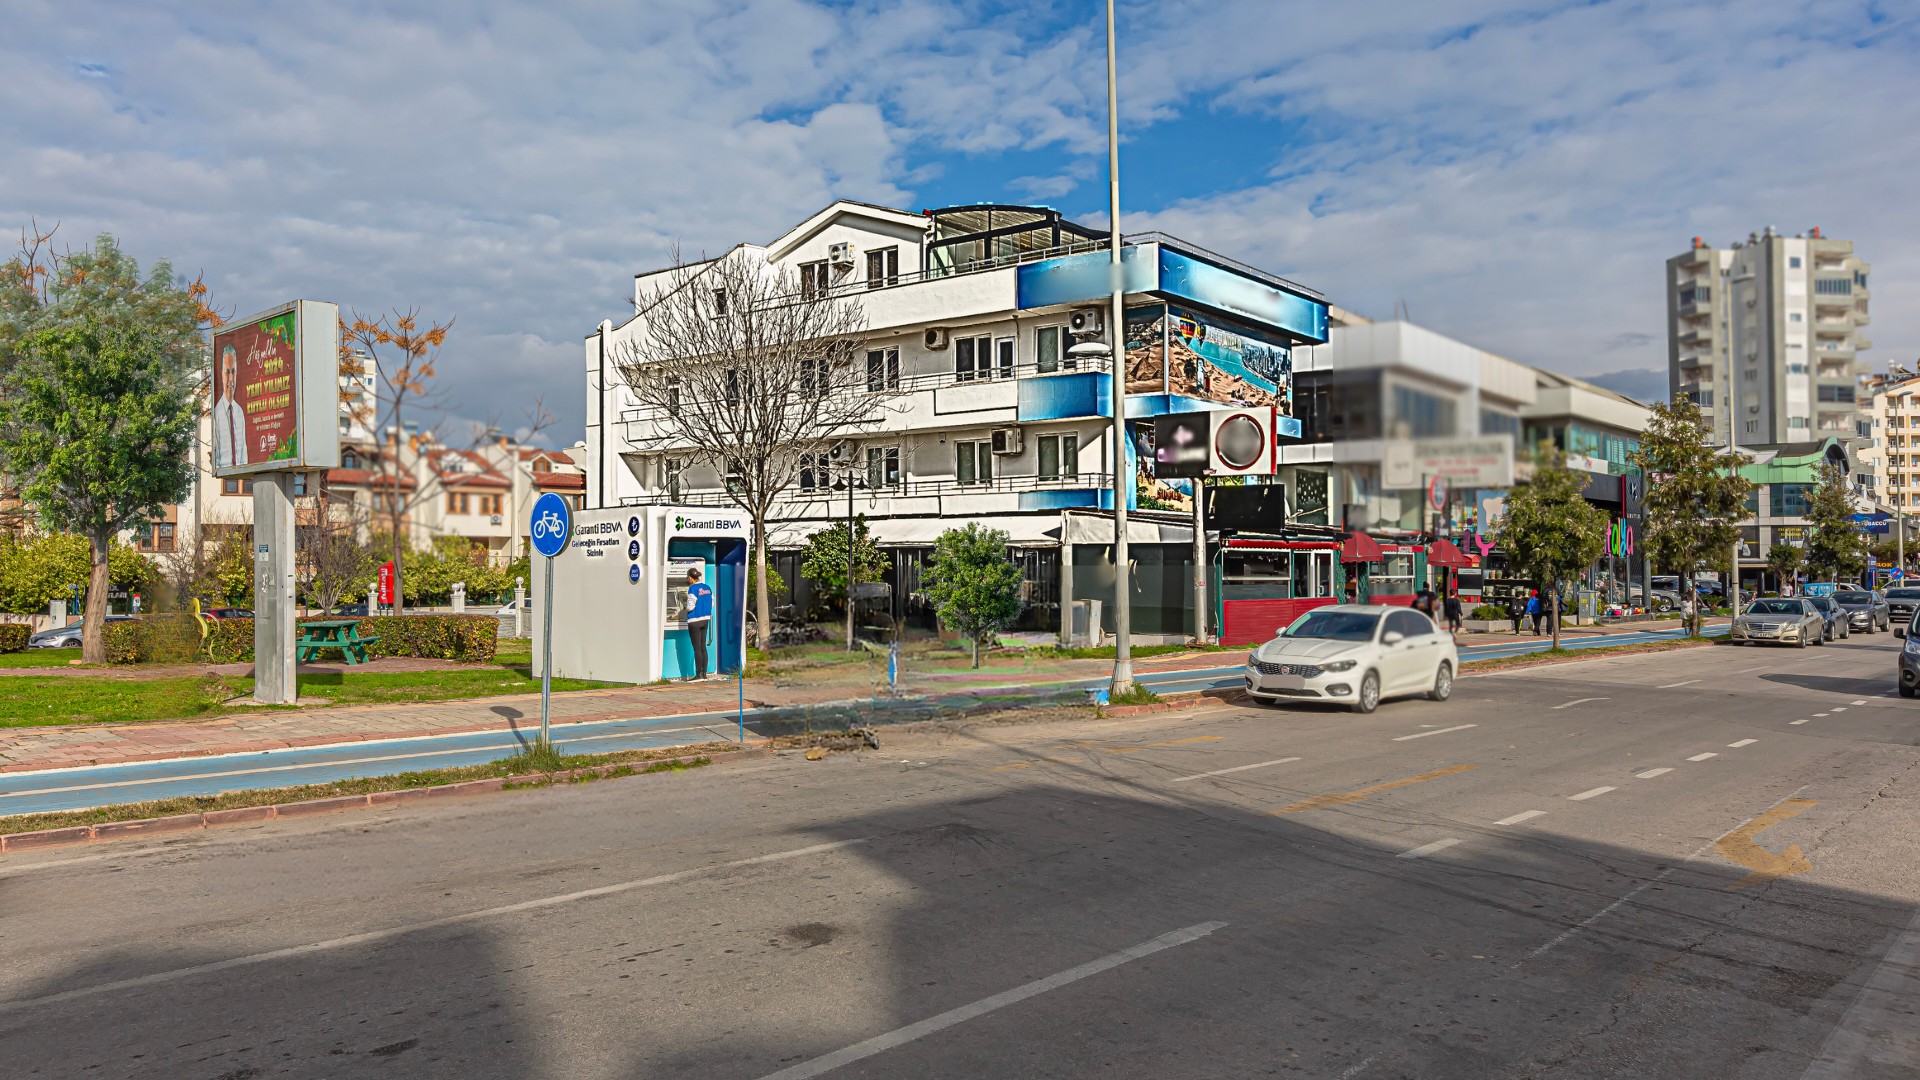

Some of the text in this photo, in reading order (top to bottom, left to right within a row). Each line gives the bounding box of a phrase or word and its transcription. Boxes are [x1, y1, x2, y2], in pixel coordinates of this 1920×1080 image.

[264, 356, 284, 376] 2024
[246, 375, 290, 398] YENİ YILIMIZ
[247, 393, 290, 414] KUTLU OLSUN
[575, 521, 623, 536] Garanti BBVA
[685, 518, 741, 529] Garanti BBVA
[572, 538, 619, 548] Geleceğin Fırsatları
[1604, 517, 1634, 558] talya
